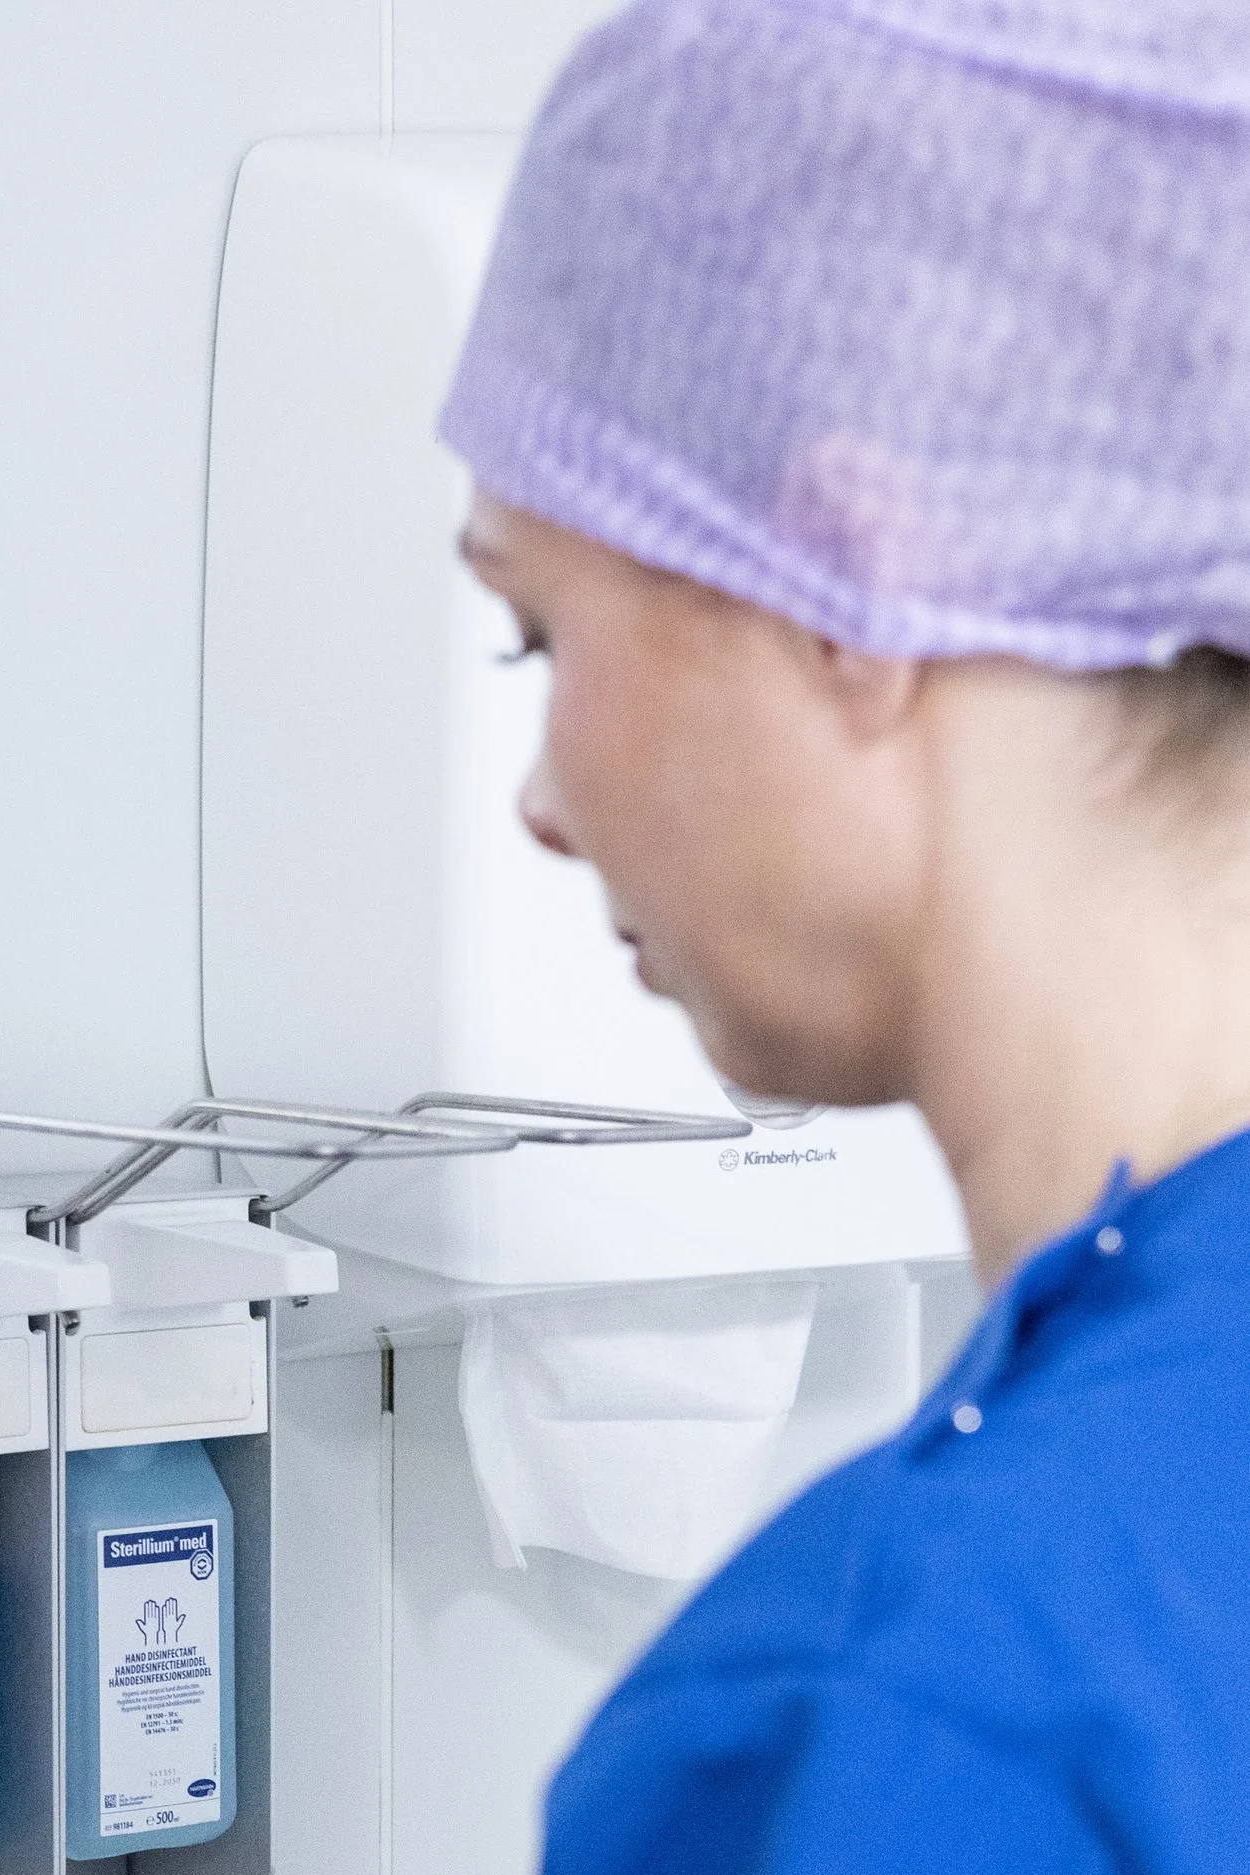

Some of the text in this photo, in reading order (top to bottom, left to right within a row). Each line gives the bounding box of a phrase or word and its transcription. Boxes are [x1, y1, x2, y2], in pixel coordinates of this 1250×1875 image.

[744, 1149, 837, 1166] Kimberly-Clark
[179, 1532, 207, 1551] med
[125, 1646, 197, 1664] HAND DISINFECTANT
[115, 1656, 206, 1677] HANDDESINFECTIEMIDDEL
[156, 1810, 174, 1824] 500
